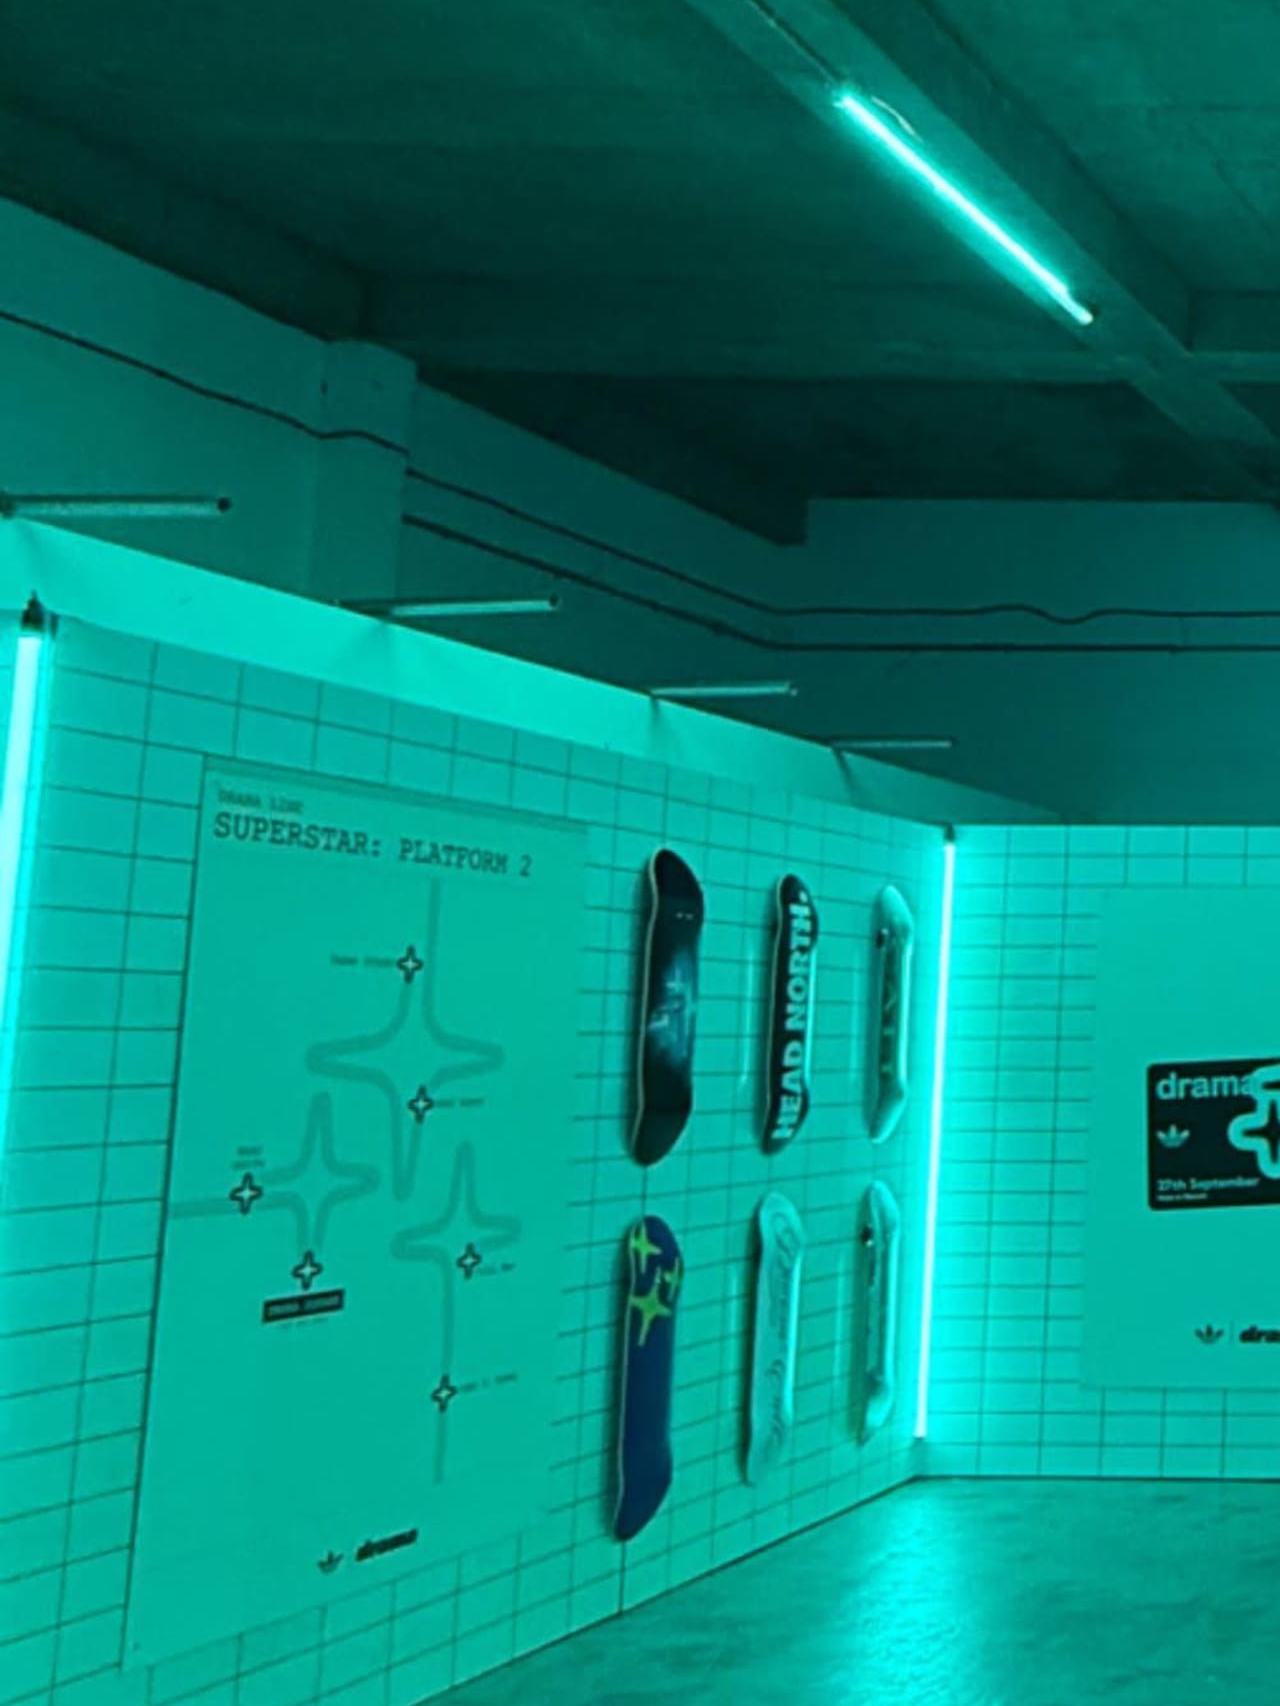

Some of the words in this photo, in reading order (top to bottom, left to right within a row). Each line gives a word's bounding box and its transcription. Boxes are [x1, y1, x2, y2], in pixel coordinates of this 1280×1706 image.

[213, 811, 381, 858] SUPERSTAR:
[399, 837, 509, 875] PLATFORM
[519, 854, 533, 878] 2
[771, 1040, 804, 1139] HEAD
